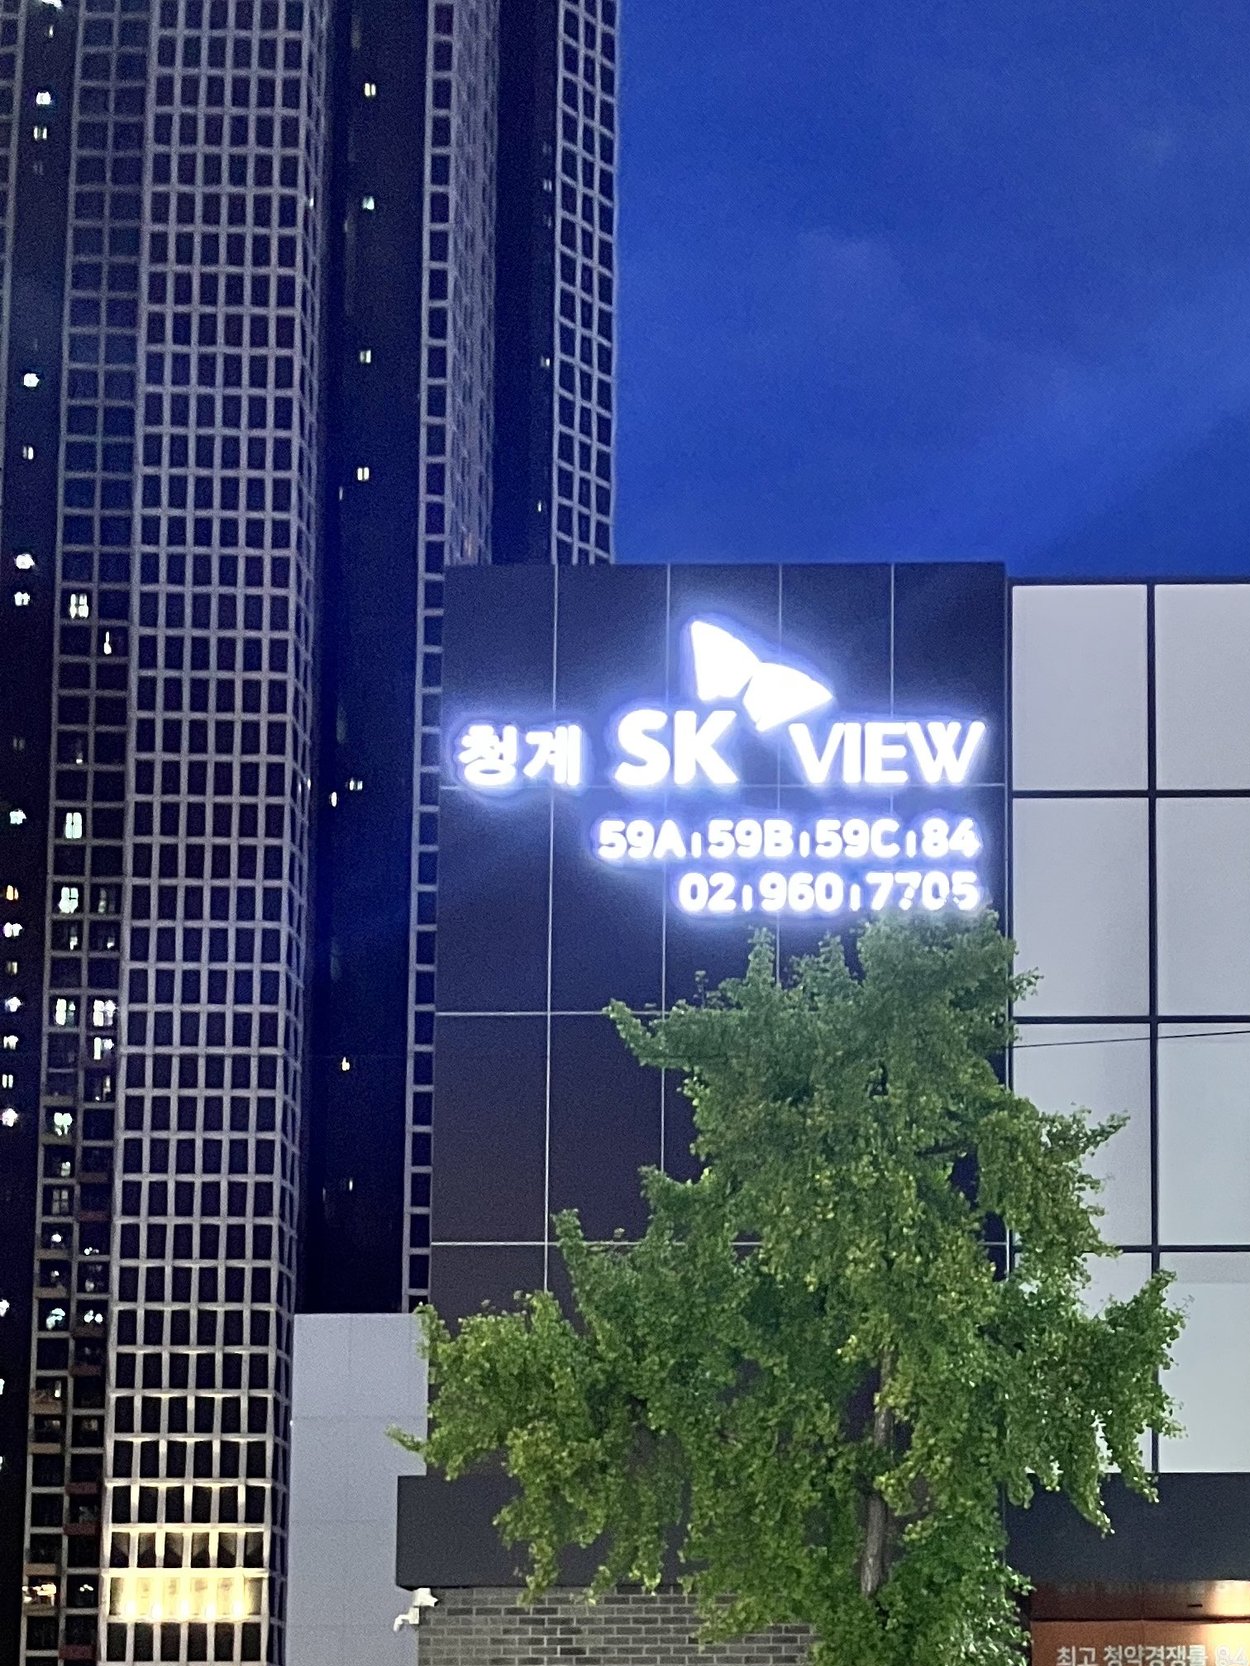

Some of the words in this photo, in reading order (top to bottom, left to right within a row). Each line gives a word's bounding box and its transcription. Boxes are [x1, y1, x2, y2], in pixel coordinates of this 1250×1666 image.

[458, 724, 583, 786] 청계
[613, 709, 739, 785] SK
[788, 721, 987, 785] VIEW
